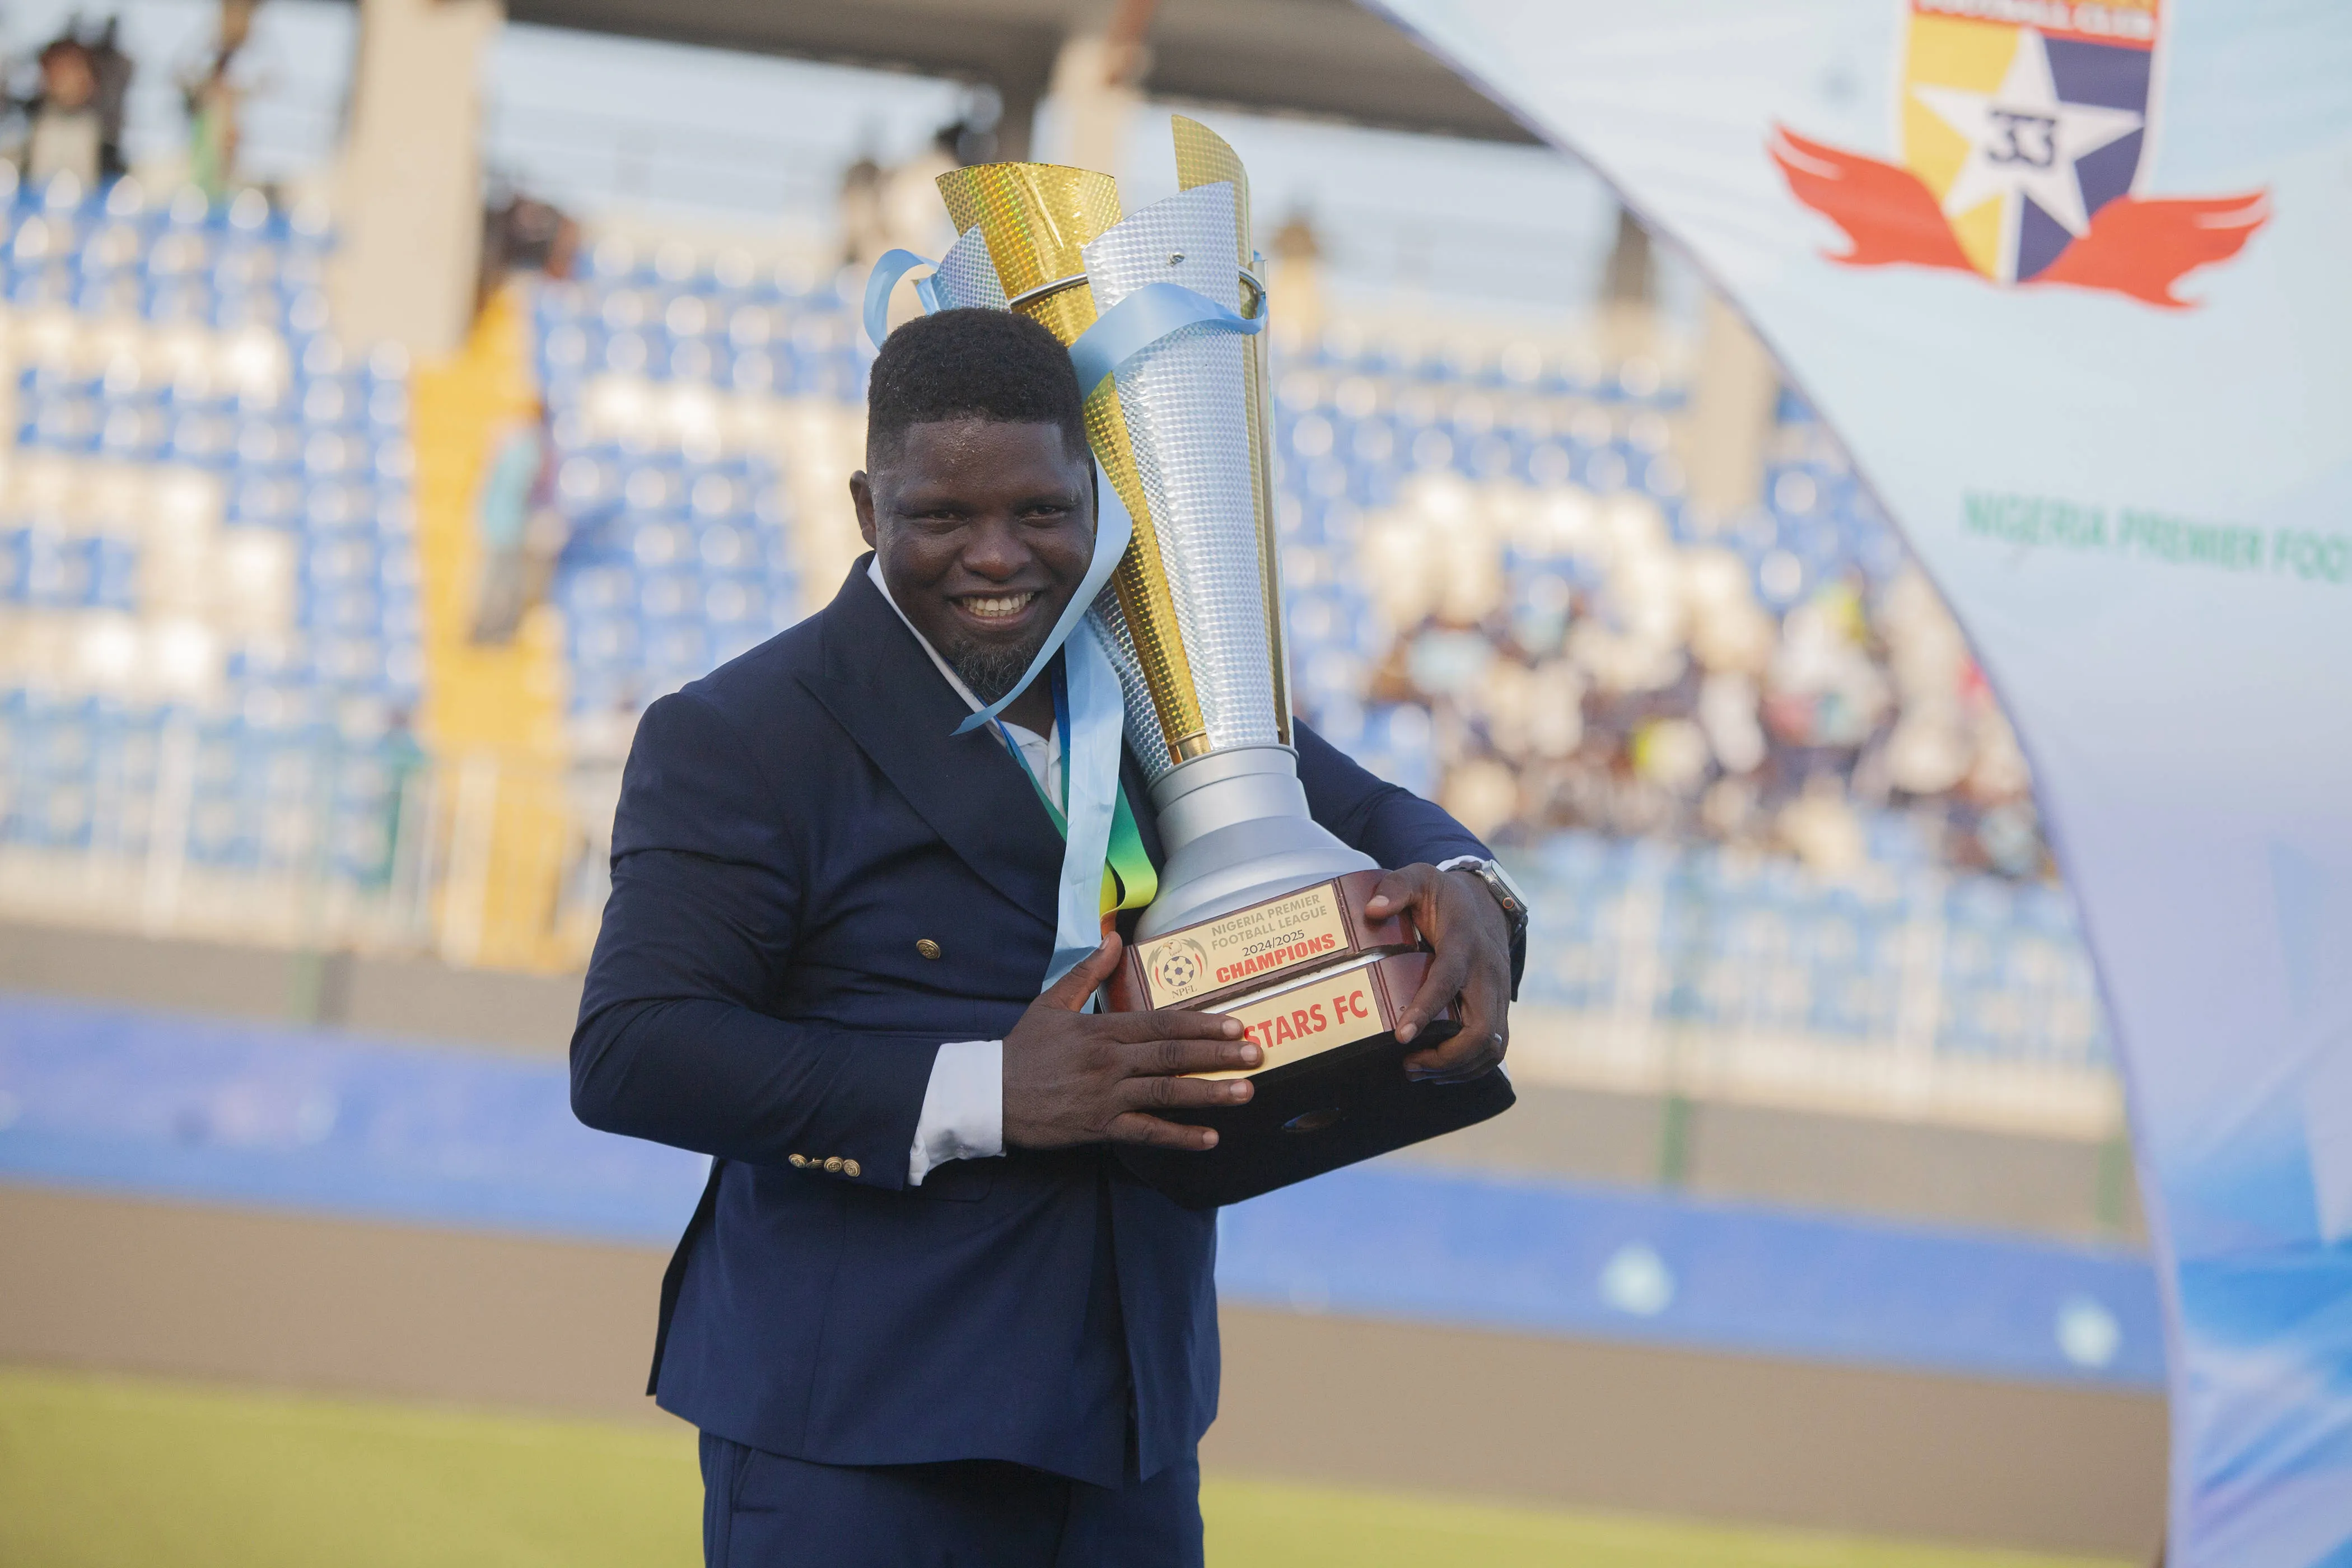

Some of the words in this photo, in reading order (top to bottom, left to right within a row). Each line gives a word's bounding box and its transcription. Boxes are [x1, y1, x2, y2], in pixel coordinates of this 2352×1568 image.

[1986, 109, 2058, 169] 33
[1961, 487, 2109, 550] NIGERIA
[2117, 505, 2266, 573] PREMIER
[1211, 912, 1263, 936] NIGERIA
[1267, 894, 1320, 918] PREMIER
[1212, 922, 1276, 950] FOOTBALL
[1279, 906, 1327, 928] LEAGUE
[1216, 934, 1336, 983] CHAMPIONS
[1242, 930, 1305, 956] 2024/2025
[1172, 986, 1197, 998] NPFL
[1244, 1004, 1327, 1048] STARS
[1333, 990, 1368, 1025] FC
